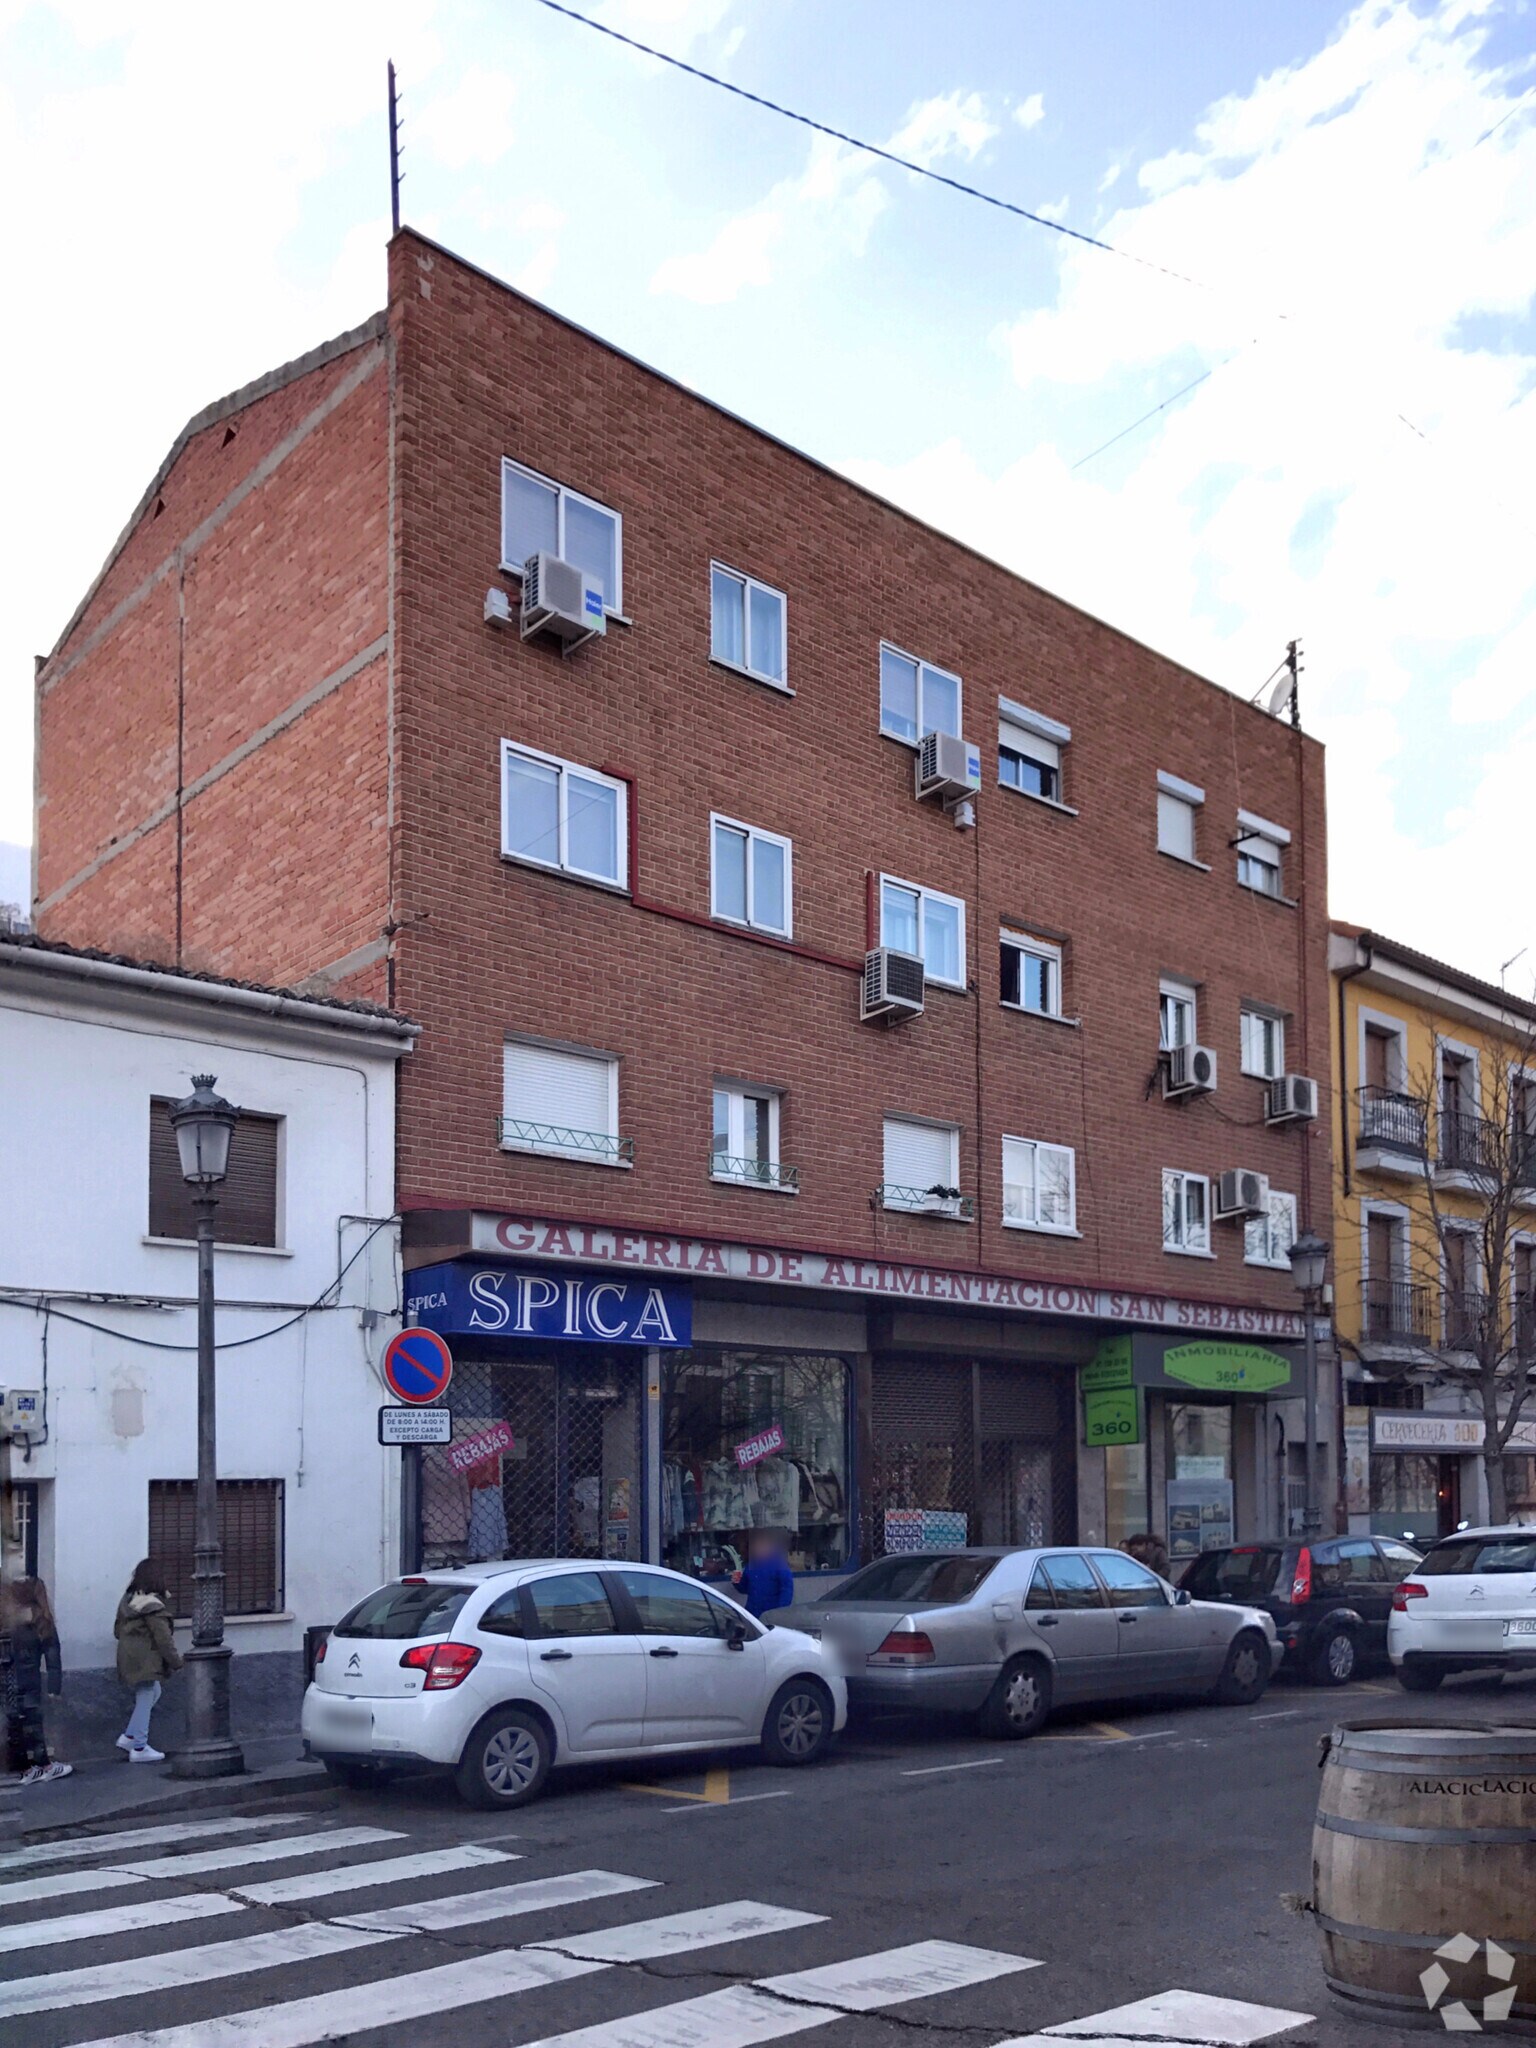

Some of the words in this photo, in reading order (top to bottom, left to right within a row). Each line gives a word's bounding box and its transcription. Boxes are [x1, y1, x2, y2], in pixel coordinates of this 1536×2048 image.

[496, 1217, 727, 1274] GALERIA
[747, 1250, 802, 1282] DE
[821, 1257, 1097, 1313] ALIMENTACION
[1110, 1294, 1166, 1322] SAN
[407, 1292, 447, 1311] SPICA
[469, 1271, 677, 1341] SPICA
[1166, 1346, 1288, 1369] INMOBILIARIA
[1216, 1370, 1238, 1384] 360
[1092, 1420, 1132, 1436] 360
[451, 1429, 509, 1469] REBAJAS
[738, 1430, 781, 1465] REBAJAS
